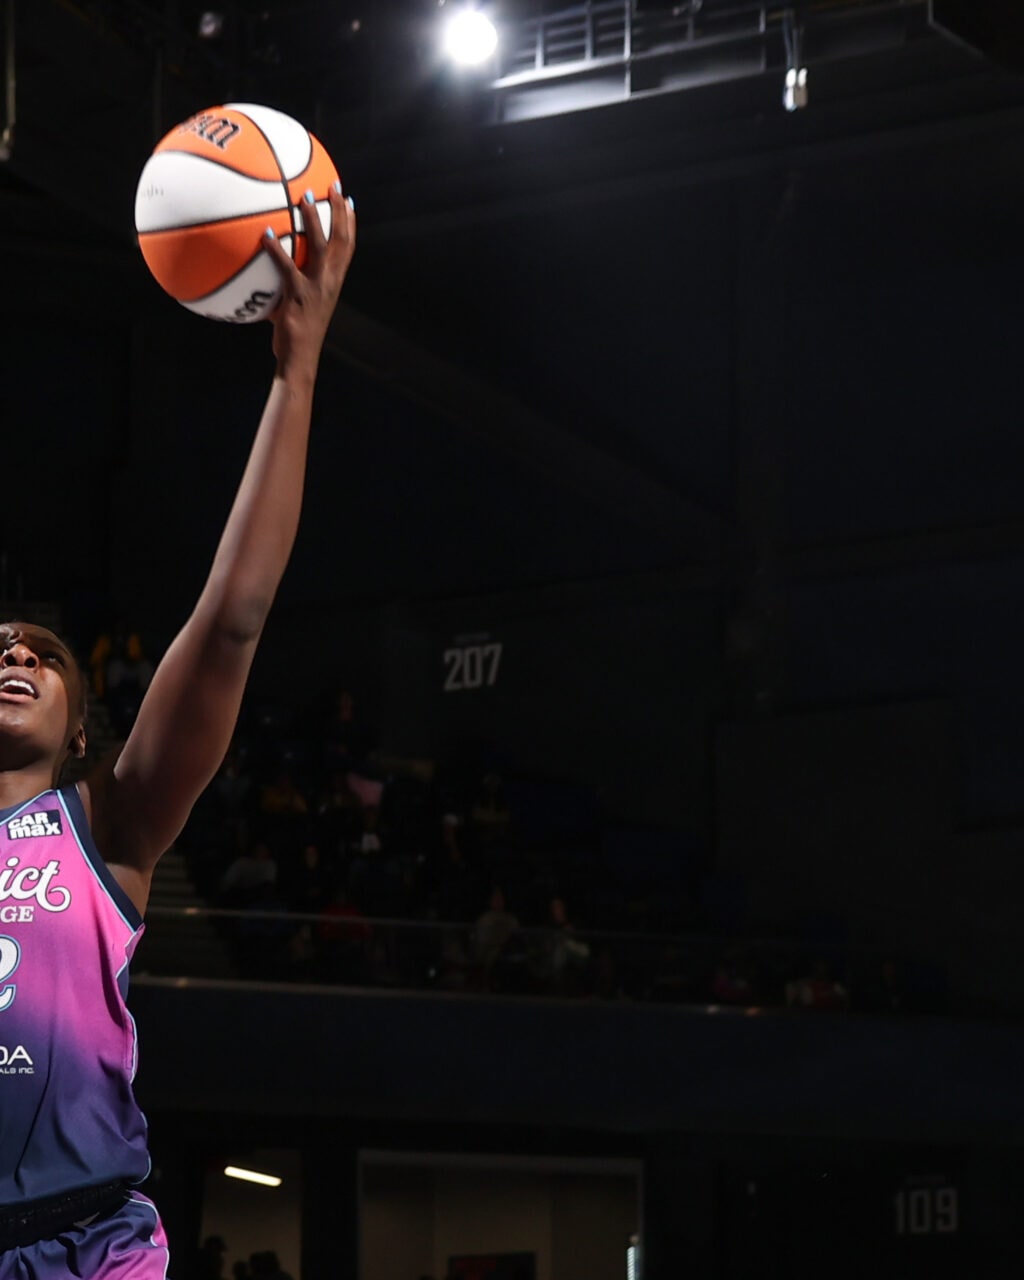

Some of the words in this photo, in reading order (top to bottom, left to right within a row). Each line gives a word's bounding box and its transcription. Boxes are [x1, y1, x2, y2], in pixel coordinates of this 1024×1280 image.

[443, 642, 504, 693] 207
[8, 811, 49, 829] CAR
[9, 822, 61, 839] max
[894, 1187, 959, 1235] 109
